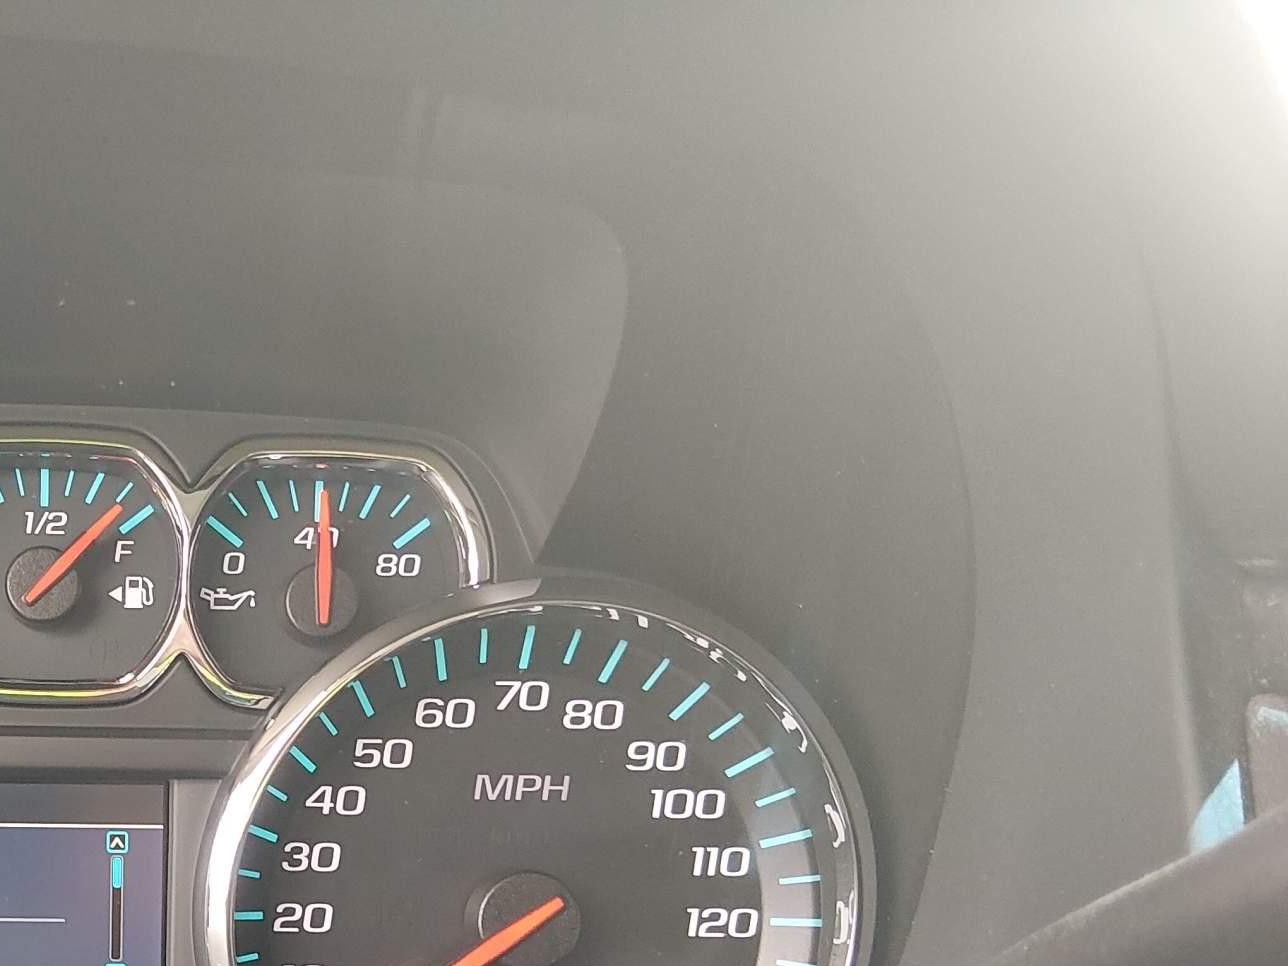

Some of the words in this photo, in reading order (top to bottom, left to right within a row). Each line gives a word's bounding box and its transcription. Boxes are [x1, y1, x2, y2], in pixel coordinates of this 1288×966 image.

[24, 511, 68, 535] 1/2
[114, 540, 135, 563] F
[223, 552, 245, 575] 0
[375, 553, 421, 577] 80
[495, 680, 550, 711] 70
[415, 698, 476, 729] 60
[562, 699, 624, 730] 80
[353, 738, 413, 769] 50
[625, 741, 687, 771] 90
[305, 785, 366, 816] 40
[474, 774, 570, 801] MPH
[651, 788, 726, 819] 100
[282, 842, 341, 872] 30
[691, 846, 751, 877] 110
[273, 903, 334, 933] 20
[686, 908, 759, 938] 120
